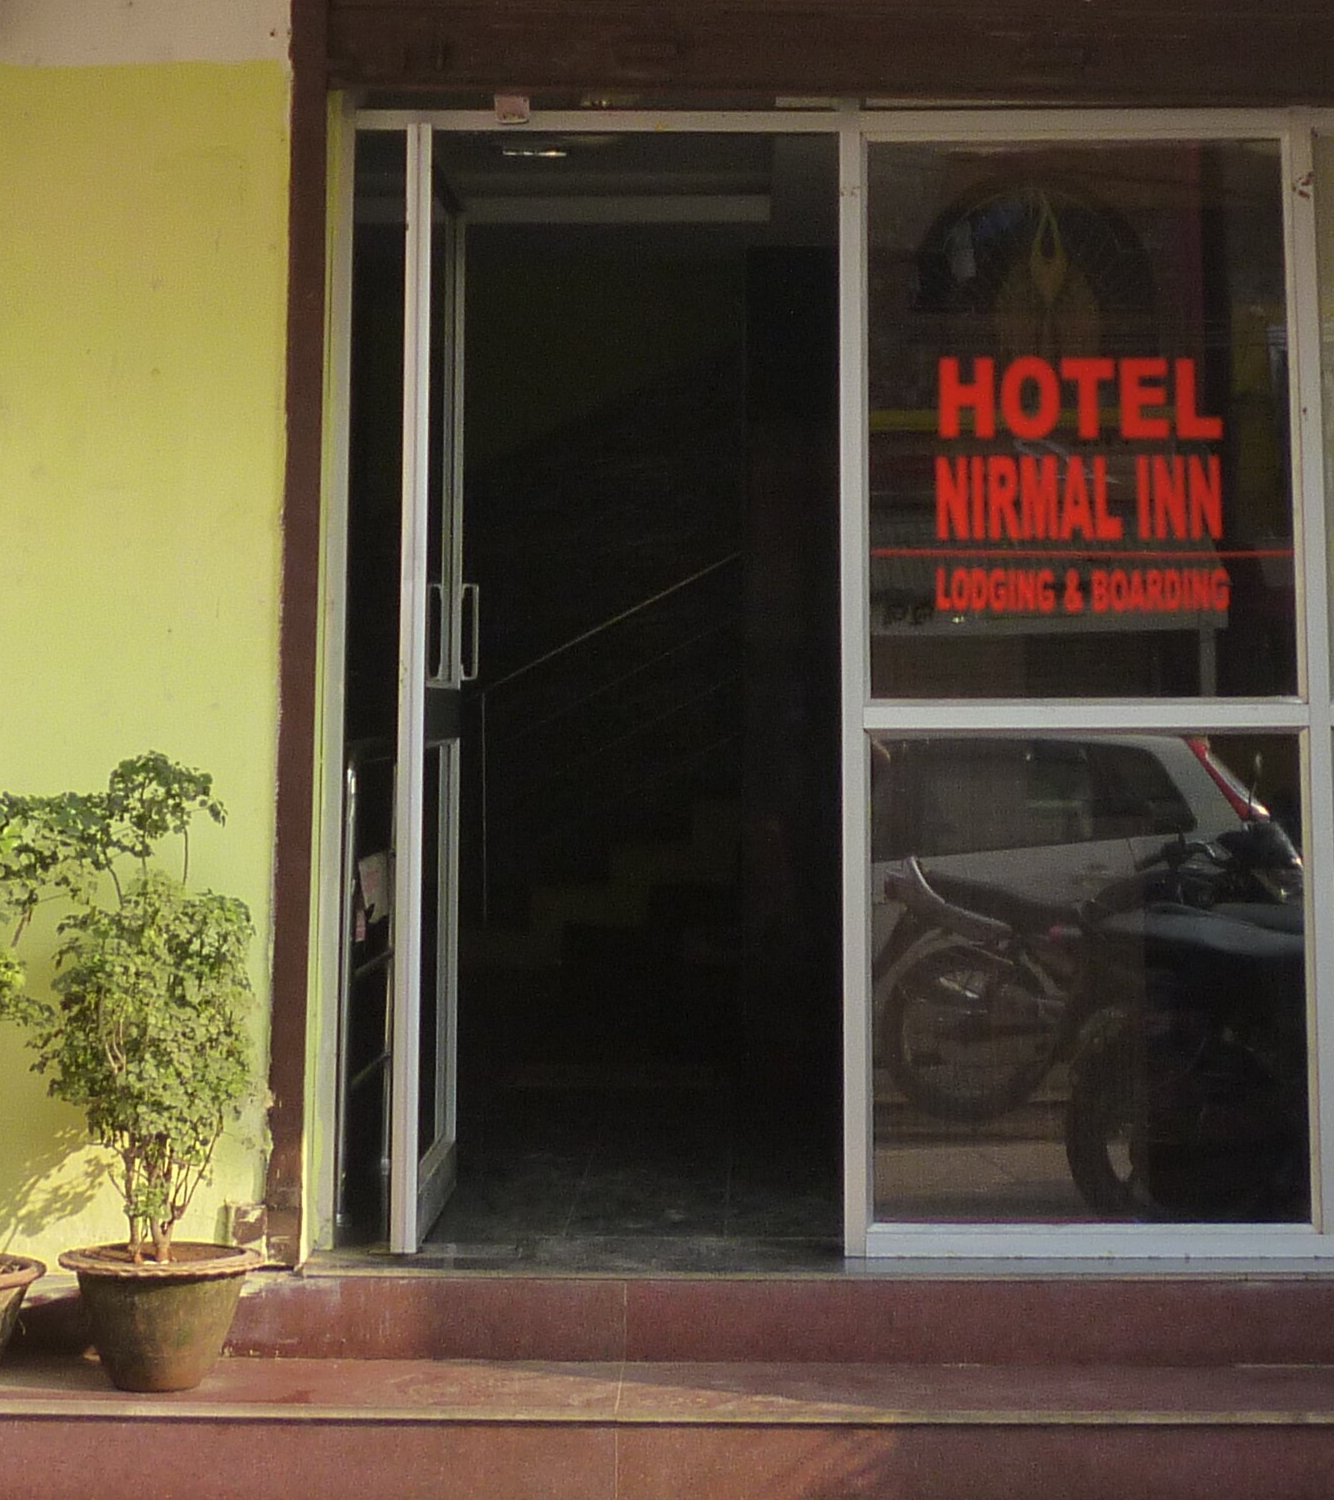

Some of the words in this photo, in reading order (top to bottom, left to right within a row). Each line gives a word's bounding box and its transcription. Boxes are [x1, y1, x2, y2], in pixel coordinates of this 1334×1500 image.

[937, 356, 1224, 440] HOTEL
[935, 454, 1123, 541] NIRMAL
[1136, 454, 1223, 541] INN
[935, 567, 1056, 612] LODGING
[1062, 568, 1085, 613] &
[1090, 567, 1231, 613] BOARDING
